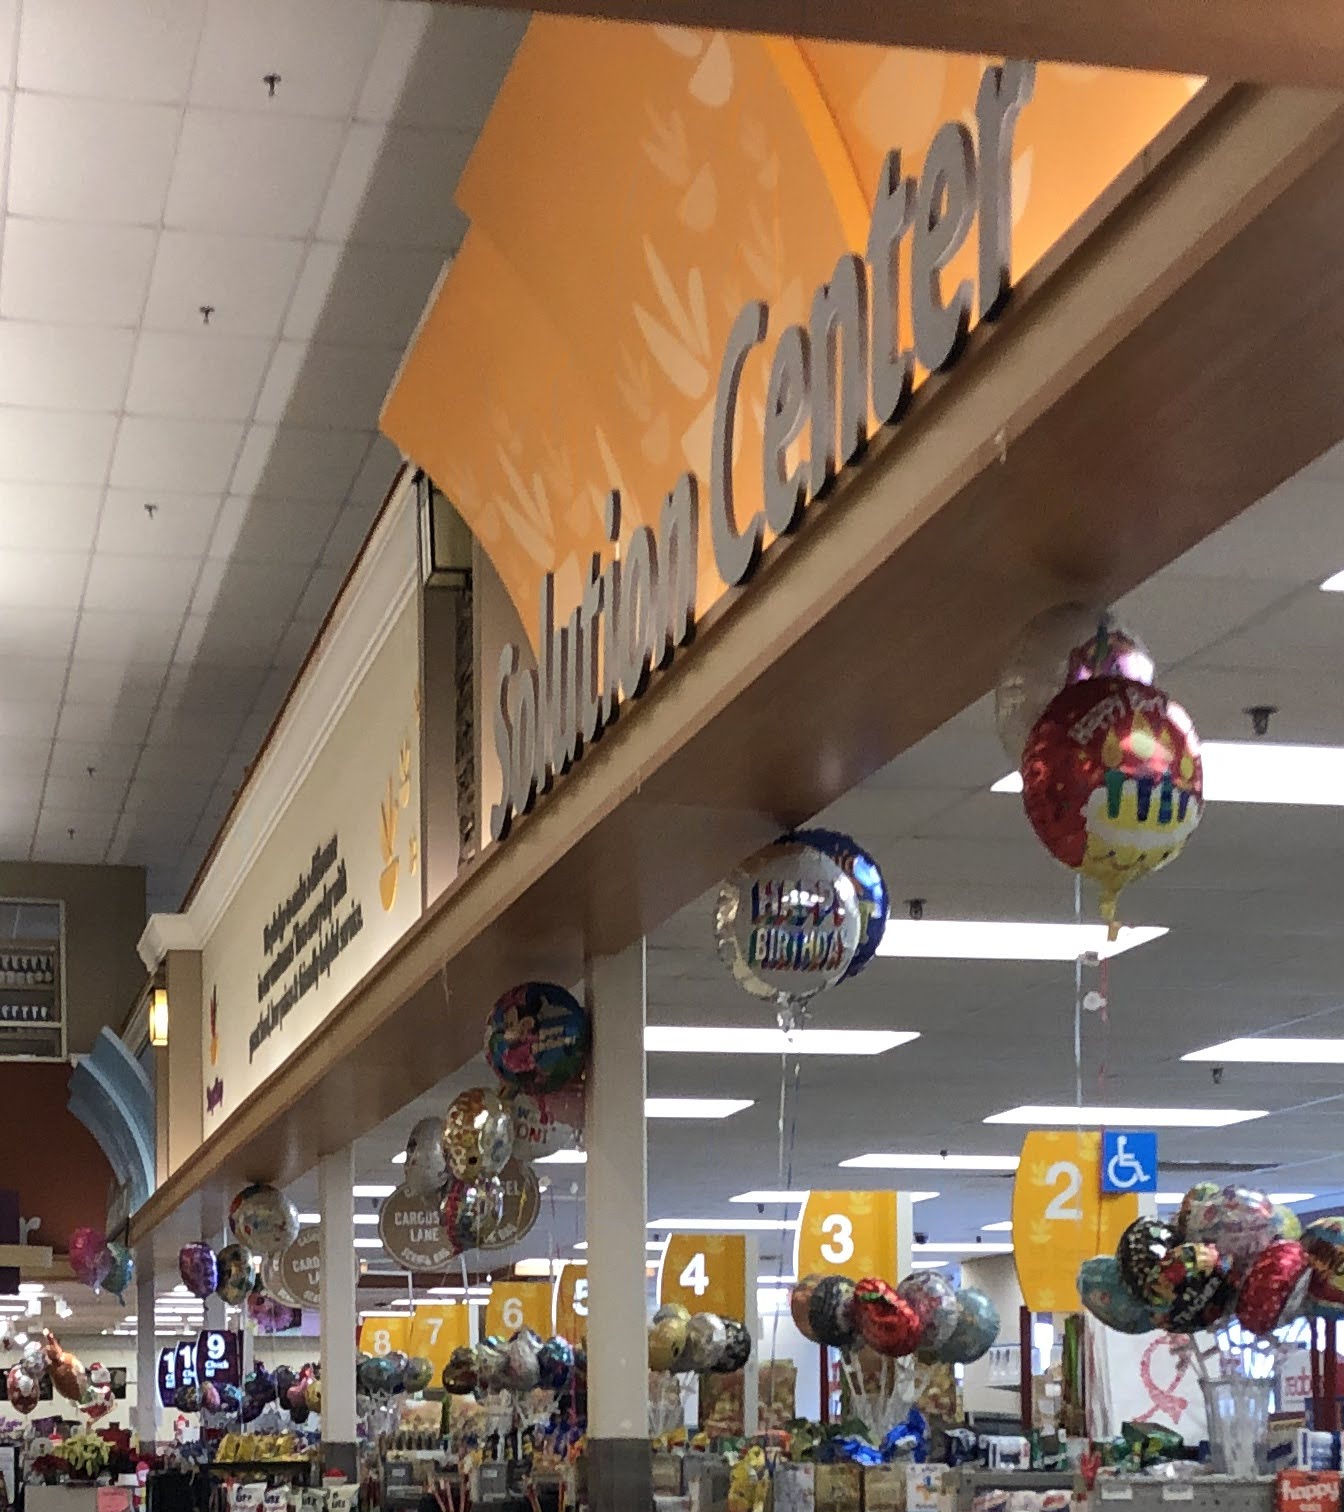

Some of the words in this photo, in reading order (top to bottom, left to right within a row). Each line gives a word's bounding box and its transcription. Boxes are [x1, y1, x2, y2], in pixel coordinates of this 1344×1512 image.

[492, 472, 699, 842] Solution
[710, 60, 1037, 587] Center
[1044, 1161, 1083, 1220] 2
[820, 1213, 854, 1264] 3
[679, 1253, 709, 1295] 4
[502, 1298, 523, 1329] 6
[207, 1333, 226, 1360] 9
[374, 1329, 392, 1356] 8
[425, 1317, 443, 1347] 7
